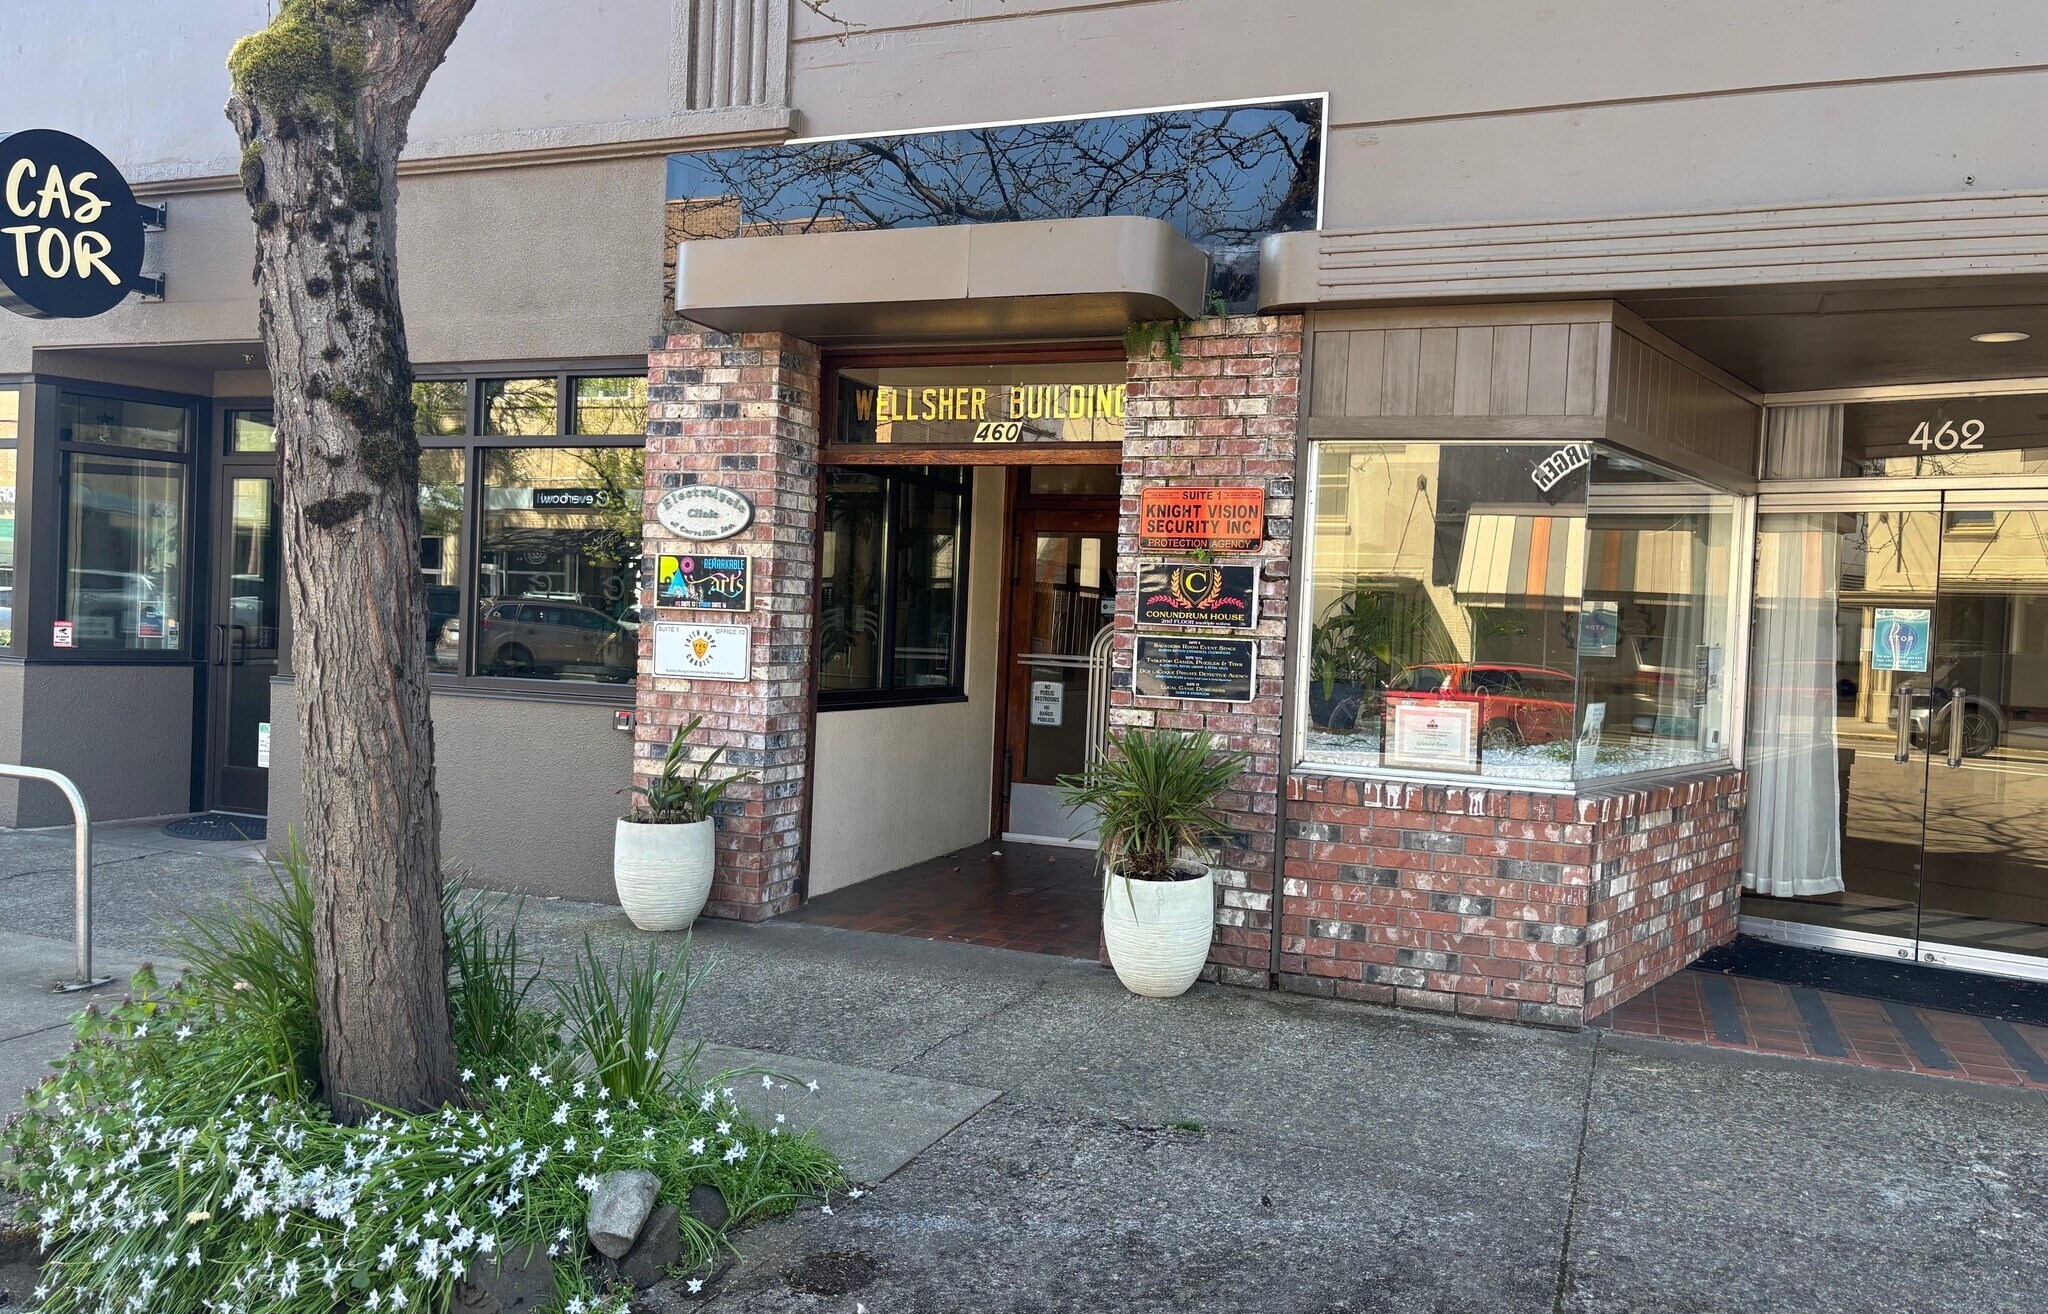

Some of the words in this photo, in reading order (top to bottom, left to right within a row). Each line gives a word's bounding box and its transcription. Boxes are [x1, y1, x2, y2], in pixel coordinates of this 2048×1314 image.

[6, 158, 111, 223] CAS
[0, 225, 121, 285] TOR
[855, 387, 985, 421] WELLSHER
[976, 424, 1019, 441] 460
[1908, 420, 1984, 450] 462
[662, 488, 746, 513] Electrolysis
[1182, 491, 1213, 500] SUITE
[687, 509, 719, 518] Clinic
[1146, 504, 1201, 518] KNIGHT
[1208, 505, 1258, 518] VISION
[1147, 520, 1219, 533] SECURITY
[1227, 521, 1255, 534] INC.
[1148, 539, 1207, 547] PROTECTION
[1212, 540, 1251, 548] AGENCY
[704, 558, 744, 570] REMARKABLE
[1186, 572, 1207, 593] C
[1146, 611, 1207, 619] CONUNDRUM
[686, 653, 713, 667] CHARITY
